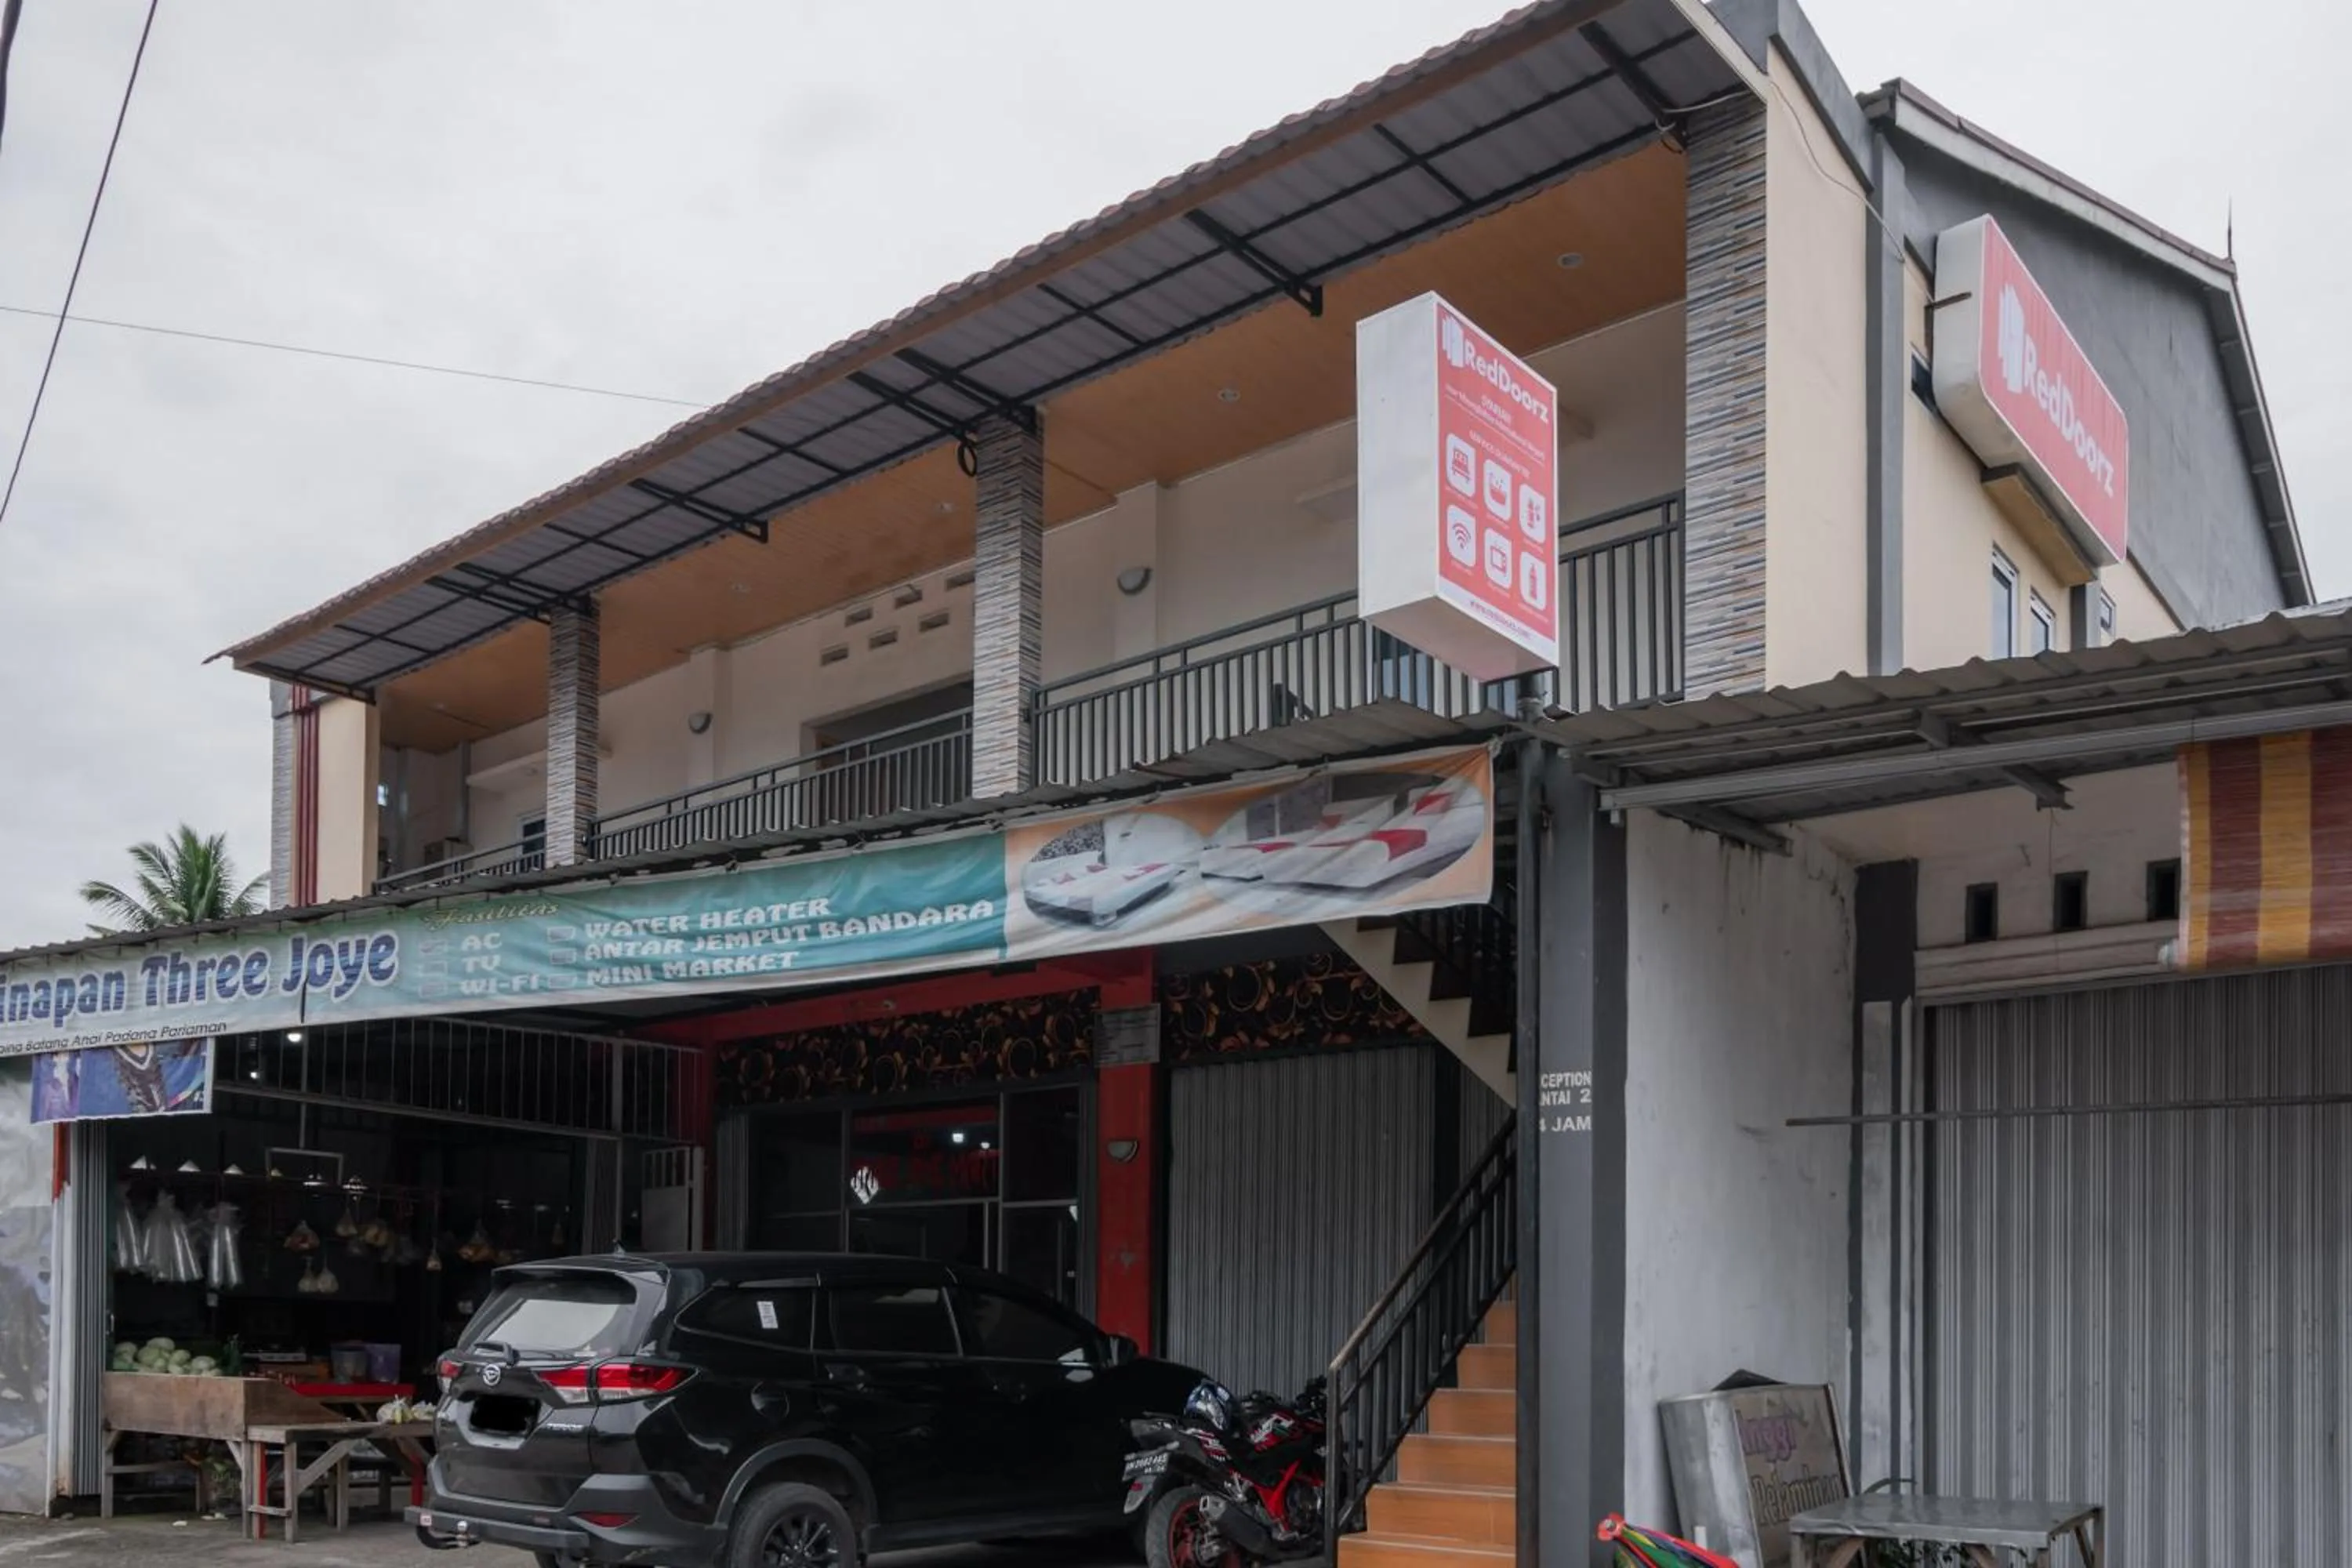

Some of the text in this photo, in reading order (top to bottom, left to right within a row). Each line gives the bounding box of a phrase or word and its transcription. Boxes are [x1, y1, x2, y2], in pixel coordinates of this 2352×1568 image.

[1464, 339, 1549, 424] RedDoorz
[2024, 334, 2115, 498] RedDoorz
[584, 899, 995, 962] ANTAR JEMPUT BANDARA
[585, 898, 832, 939] WATER HEATER
[460, 932, 503, 951] AC
[140, 950, 269, 1007] Three
[281, 933, 397, 999] Joye
[459, 974, 540, 995] WI-FI
[586, 950, 800, 987] MINI MARKET
[1580, 1088, 1592, 1103] 2
[1552, 1116, 1592, 1132] JAM
